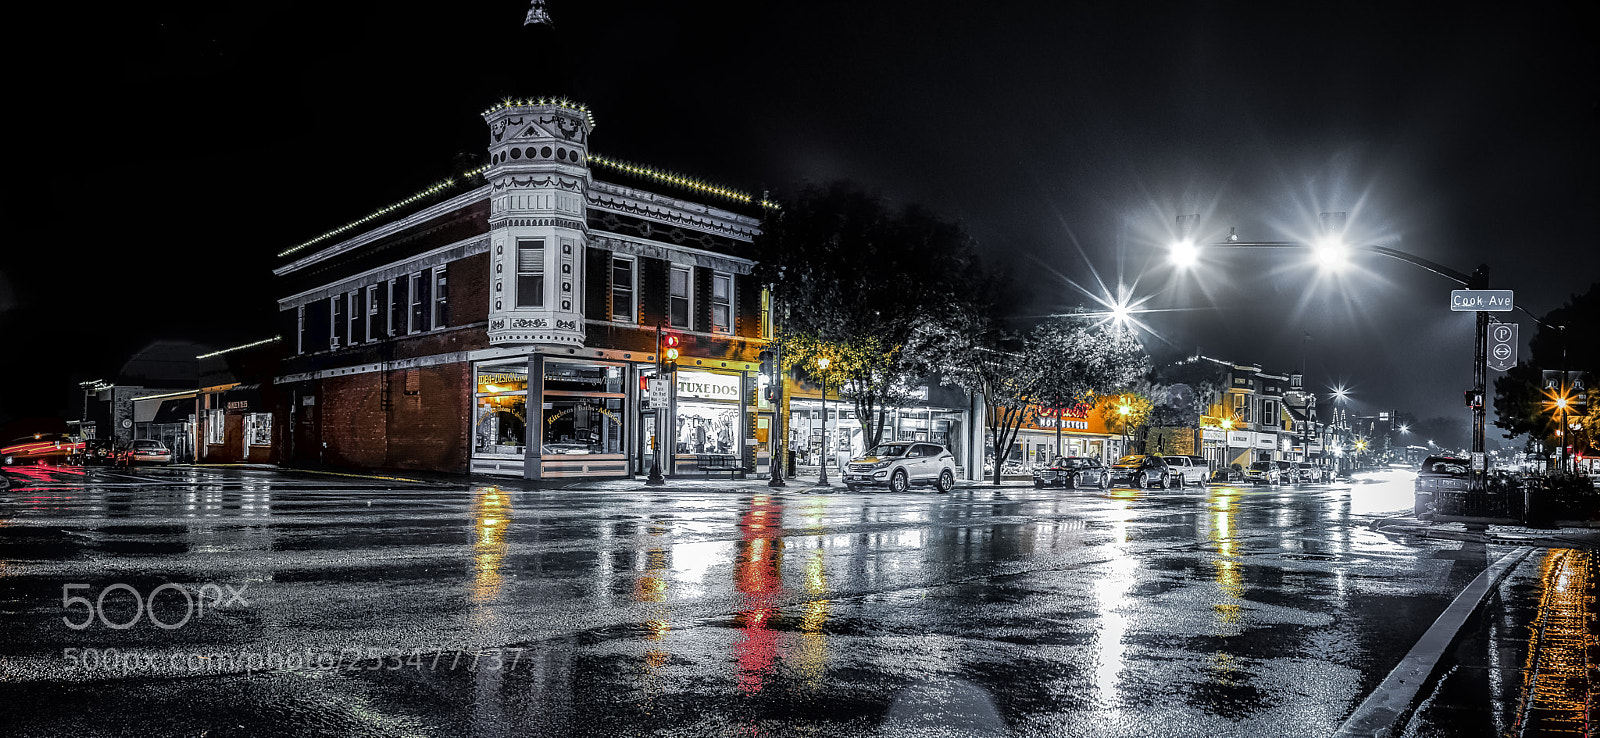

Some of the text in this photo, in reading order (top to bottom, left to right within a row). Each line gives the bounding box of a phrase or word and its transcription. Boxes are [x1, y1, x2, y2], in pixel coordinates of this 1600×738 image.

[1453, 295, 1511, 306] Cook Ave
[1499, 329, 1508, 339] P
[678, 381, 738, 396] TUXEDOS
[547, 407, 574, 425] Kitchens
[598, 406, 622, 426] Additions
[1039, 418, 1089, 430] MOTRCYCLE
